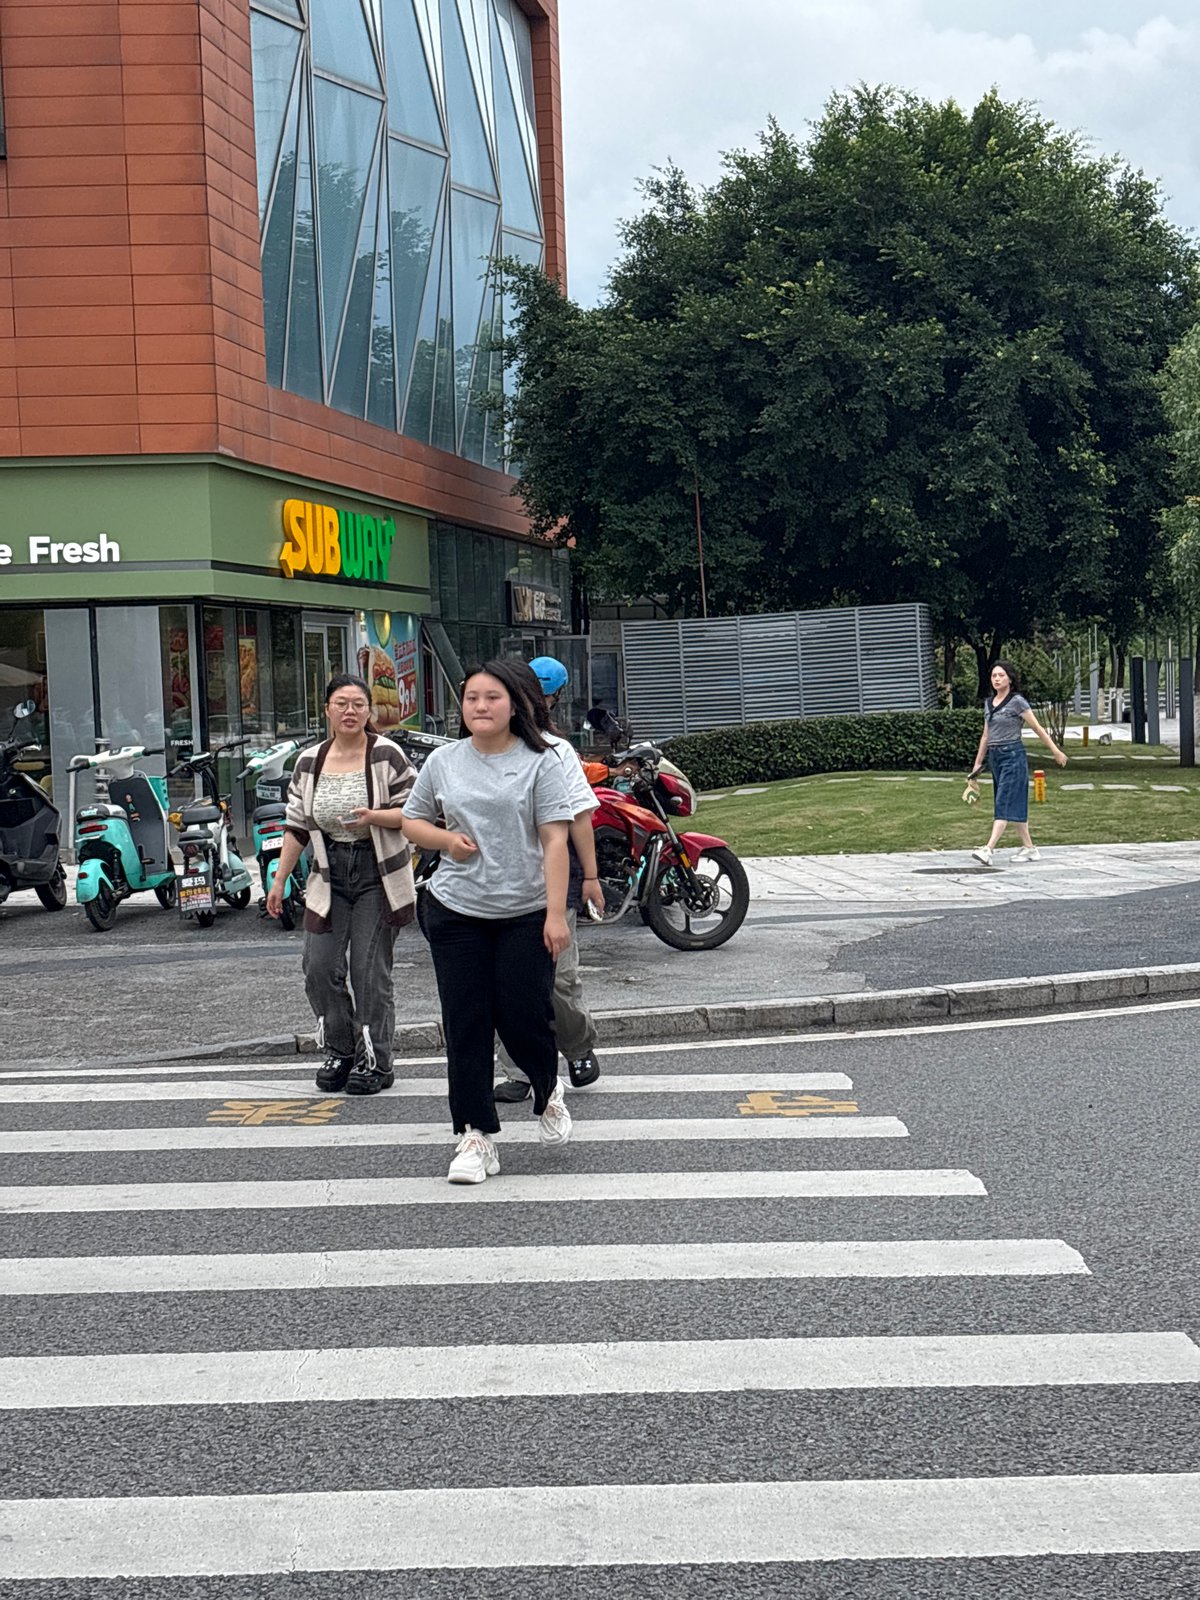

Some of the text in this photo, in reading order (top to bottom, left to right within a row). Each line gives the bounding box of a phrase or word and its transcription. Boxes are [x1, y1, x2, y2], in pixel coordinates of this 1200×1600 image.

[29, 533, 120, 564] Fresh
[278, 498, 396, 580] SUBWAY
[170, 739, 194, 747] FRESH
